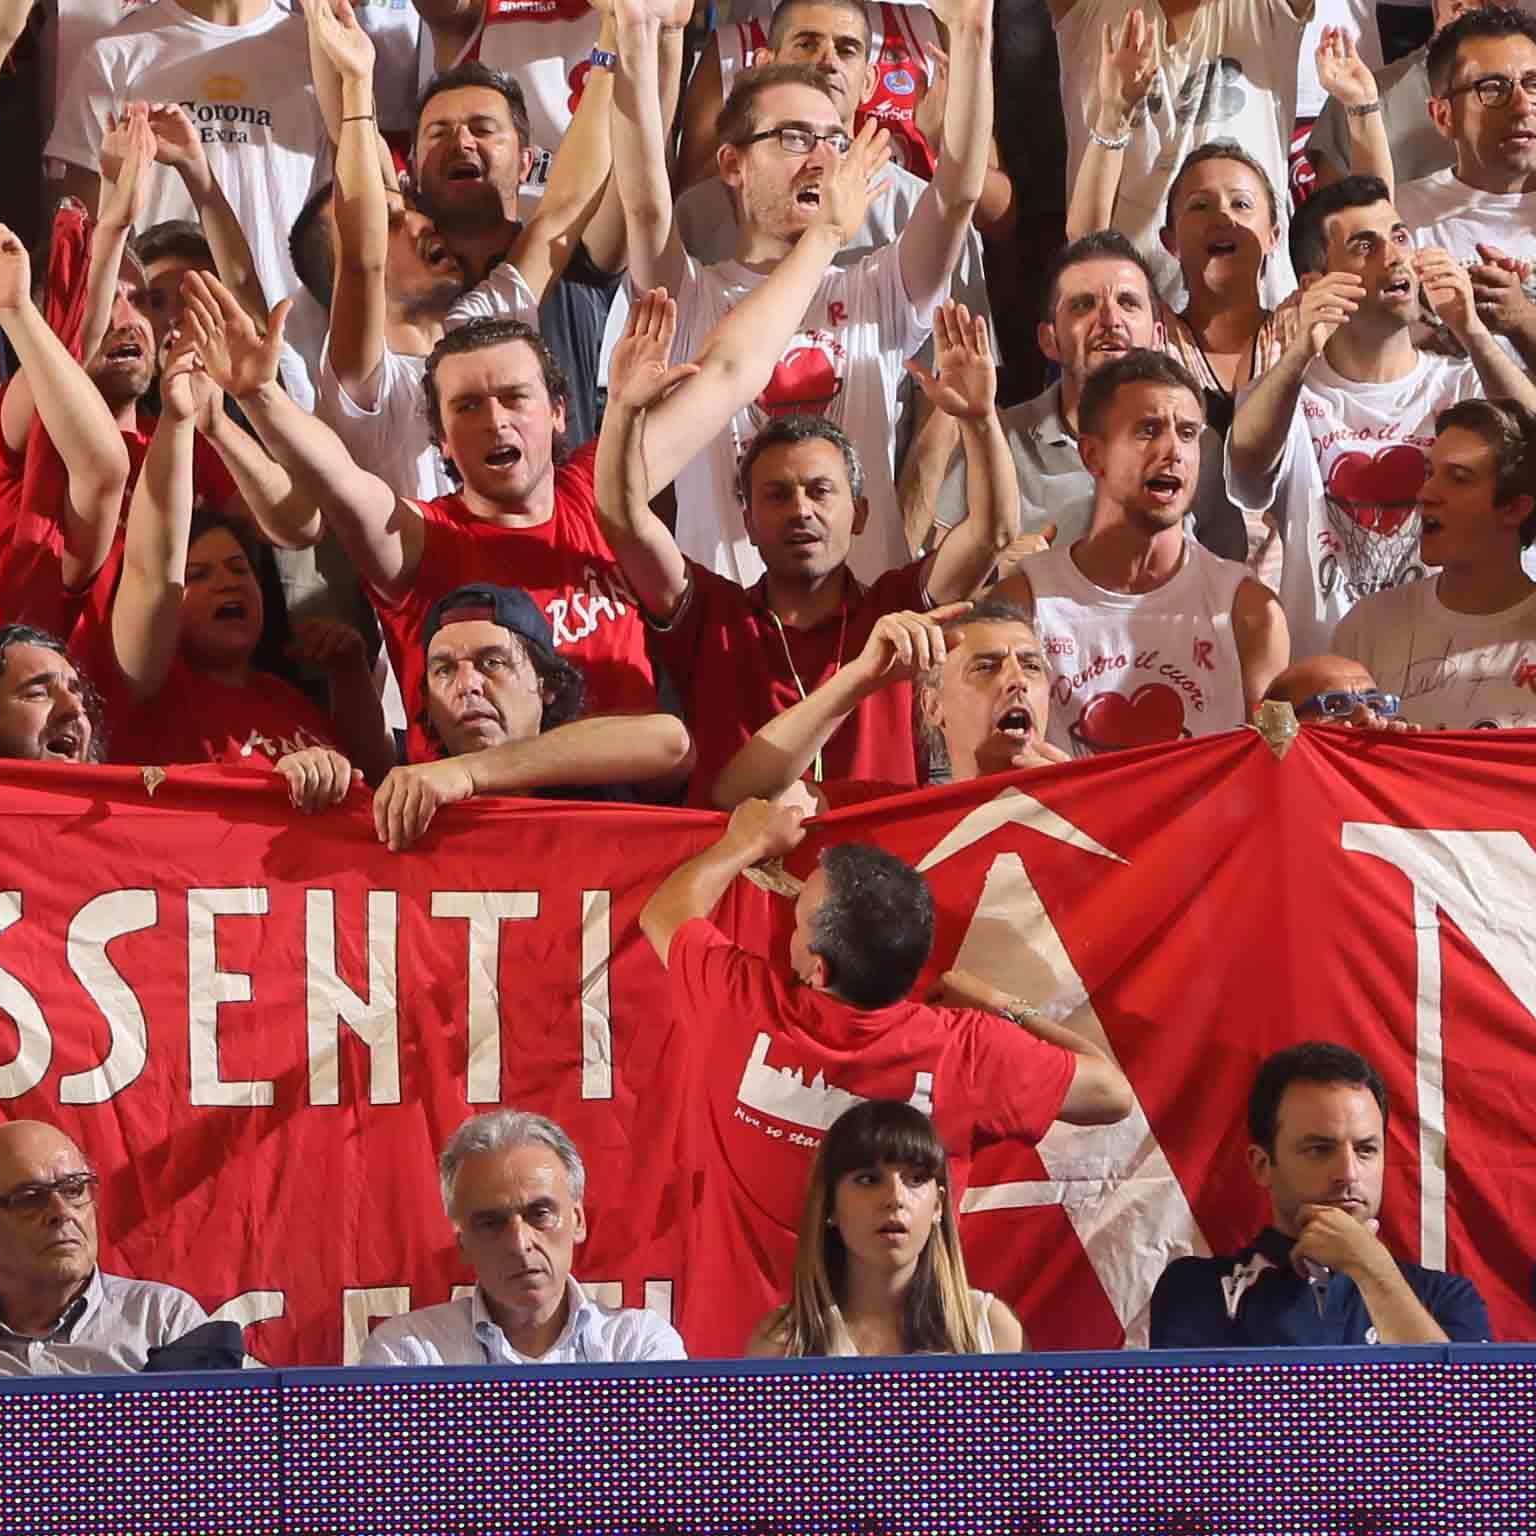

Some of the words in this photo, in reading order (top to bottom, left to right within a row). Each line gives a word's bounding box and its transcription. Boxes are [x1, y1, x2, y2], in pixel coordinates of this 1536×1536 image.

[1050, 653, 1129, 707] Dentro
[1134, 650, 1160, 671] il
[764, 1125, 785, 1139] so
